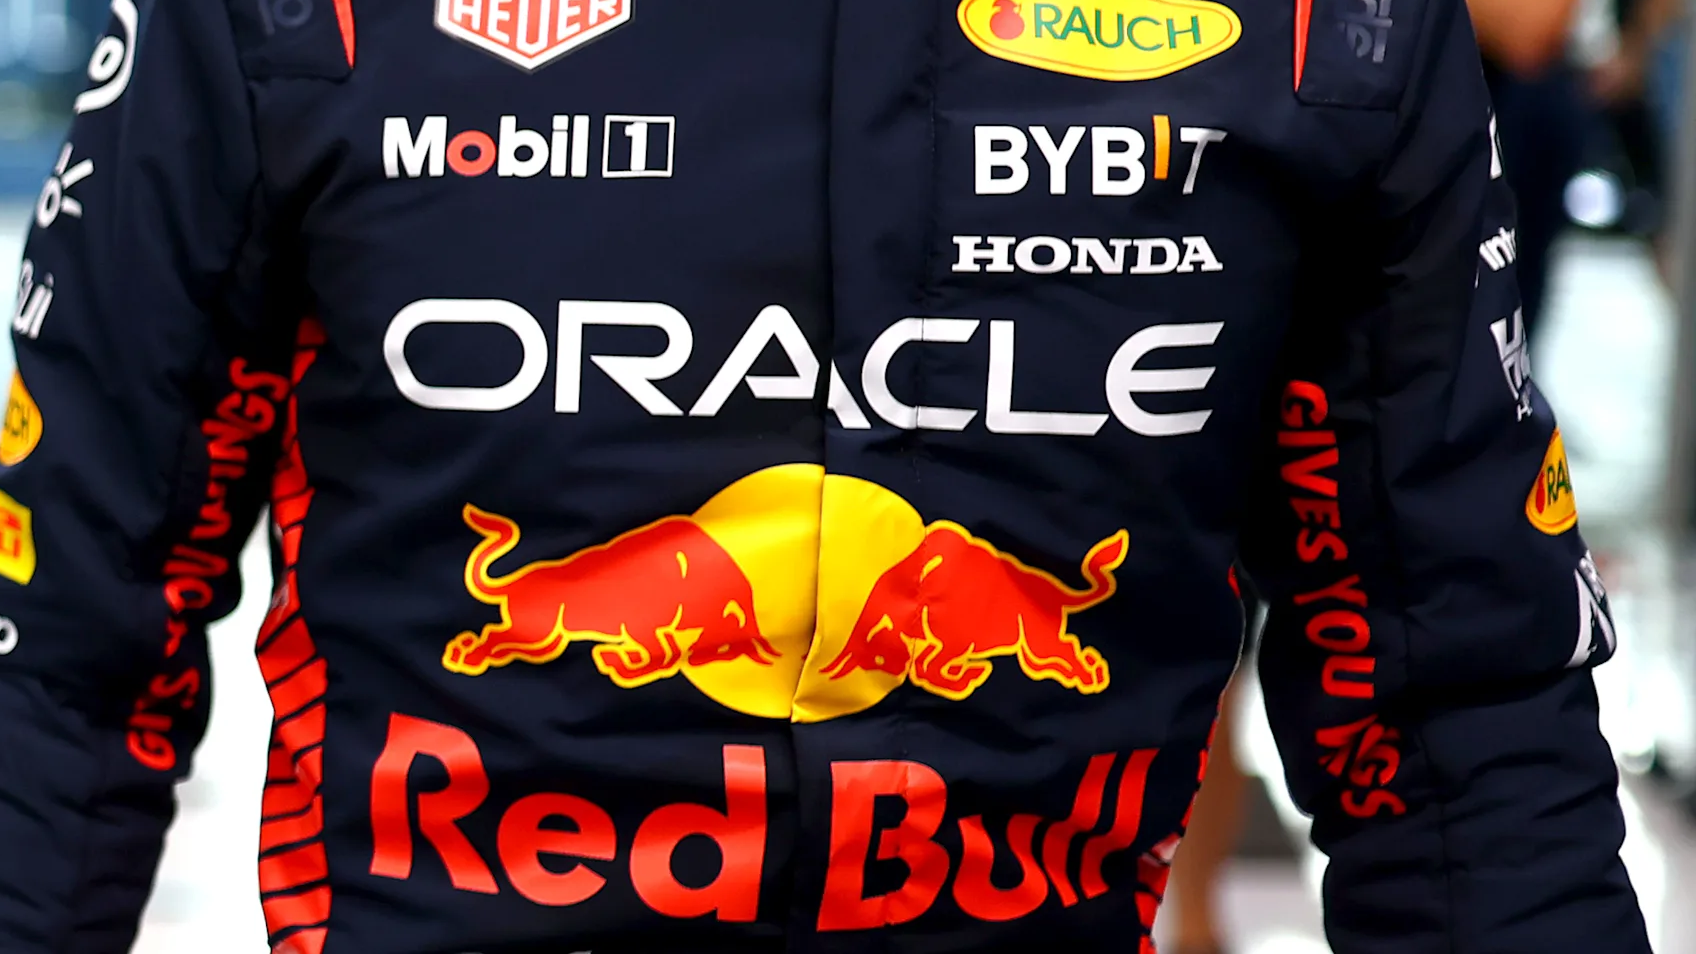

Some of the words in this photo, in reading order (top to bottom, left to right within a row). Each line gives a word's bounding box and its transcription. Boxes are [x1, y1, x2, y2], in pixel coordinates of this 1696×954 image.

[1033, 1, 1203, 52] RAUCH
[382, 114, 591, 179] Mobil
[973, 115, 1228, 197] BYBIT
[951, 235, 1224, 275] HONDA
[382, 297, 1227, 437] ORACLE
[1276, 379, 1350, 564] GIVES
[1292, 573, 1377, 700] YOU
[125, 666, 201, 772] GIS
[368, 710, 768, 924] Red
[816, 747, 1161, 933] Bull
